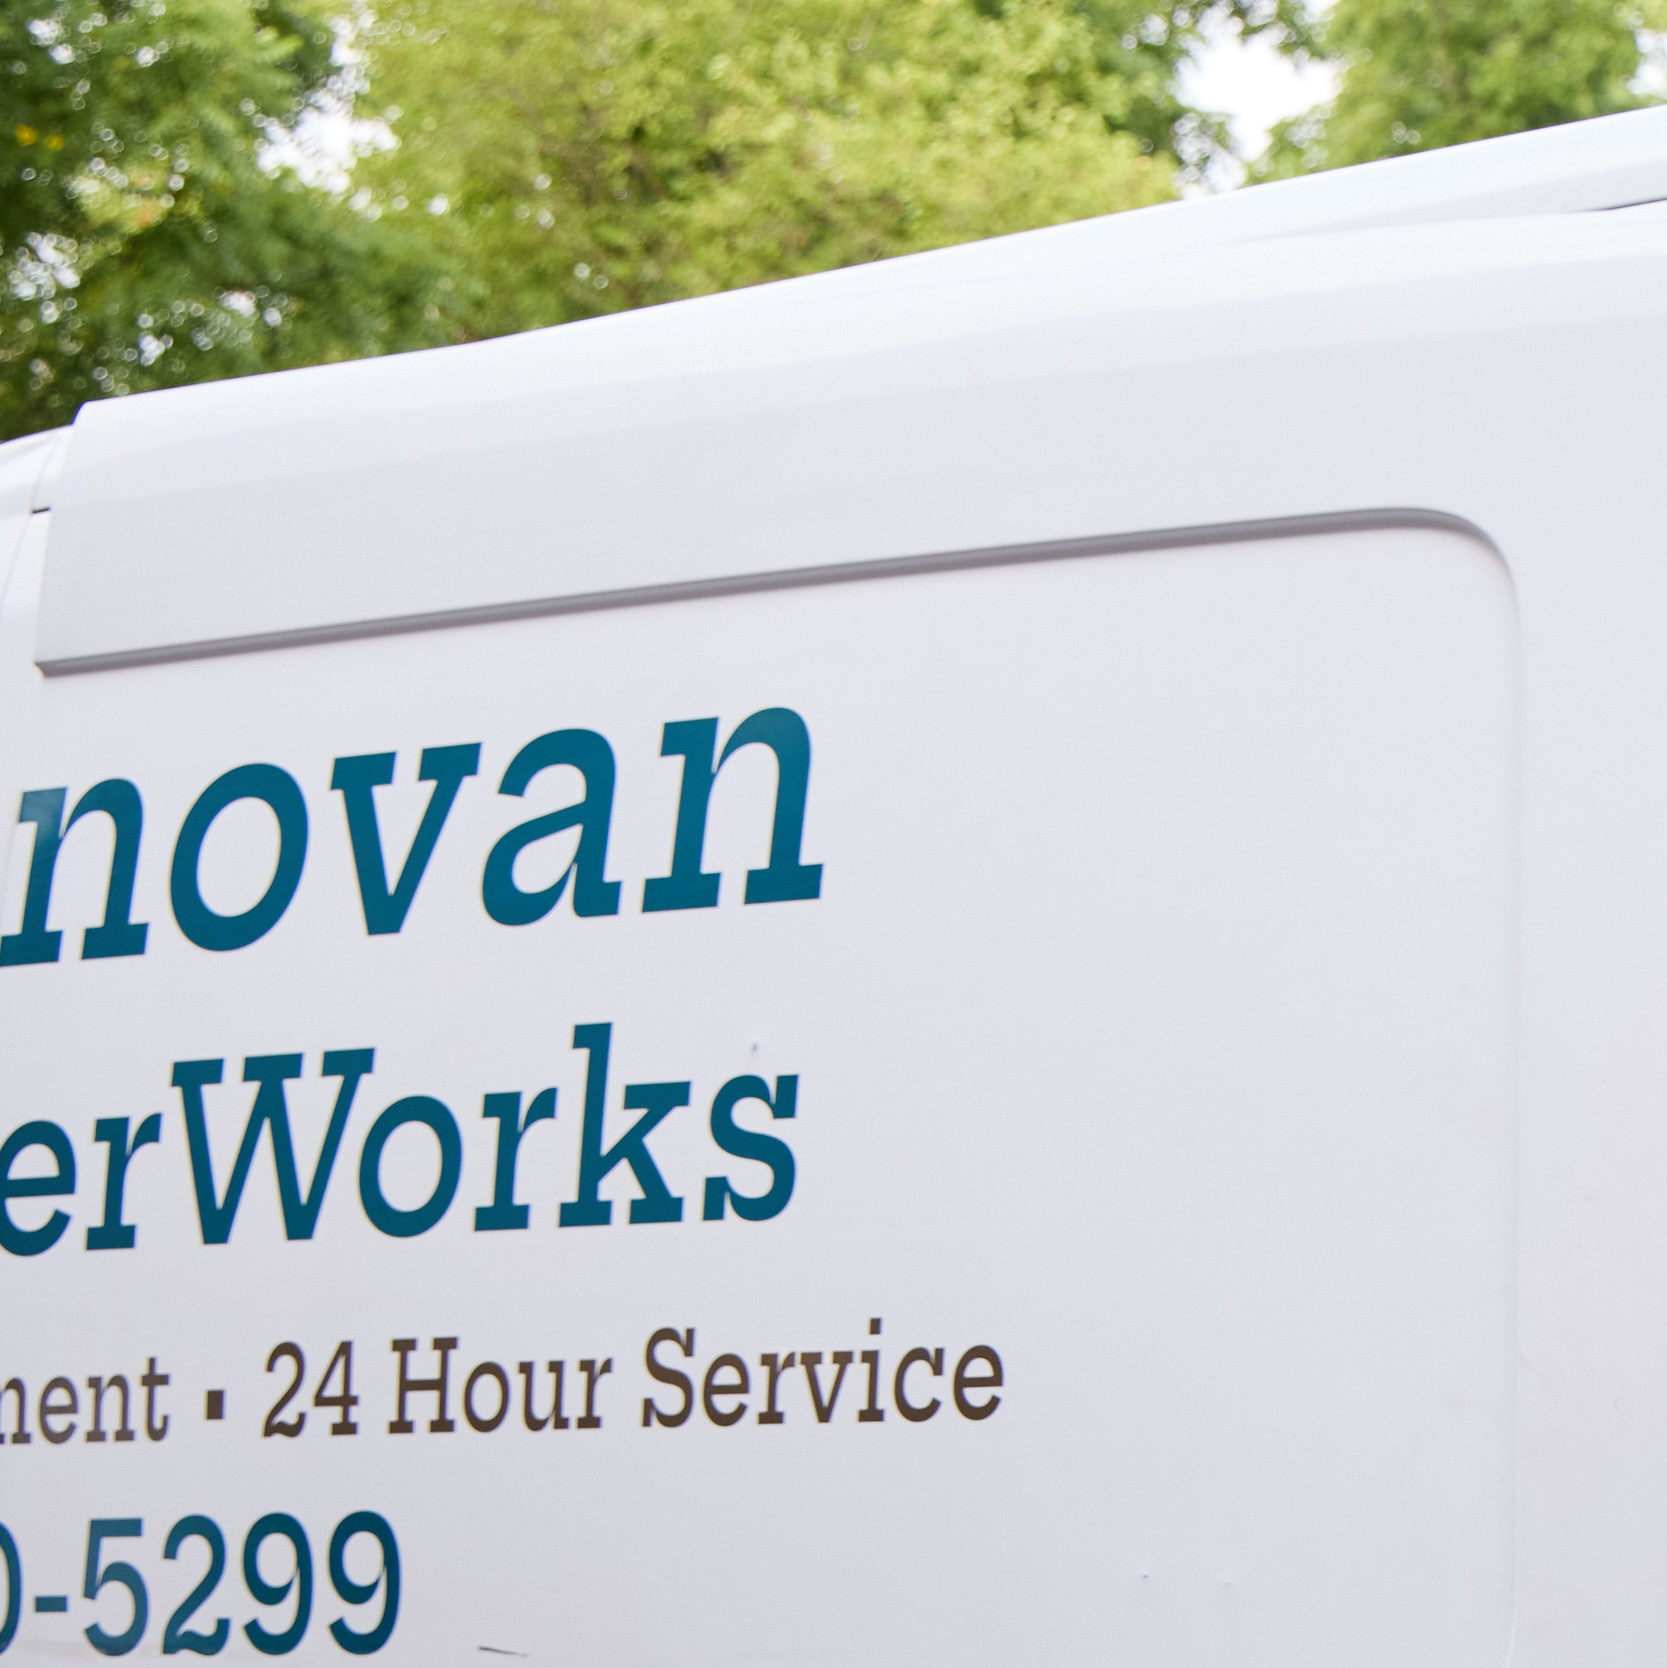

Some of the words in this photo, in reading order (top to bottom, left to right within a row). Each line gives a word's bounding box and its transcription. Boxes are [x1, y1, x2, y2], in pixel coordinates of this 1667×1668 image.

[0, 706, 823, 967] novan
[0, 1022, 799, 1256] erWorks
[262, 1340, 358, 1438] 24
[387, 1335, 613, 1434] Hour
[642, 1317, 1003, 1429] Service
